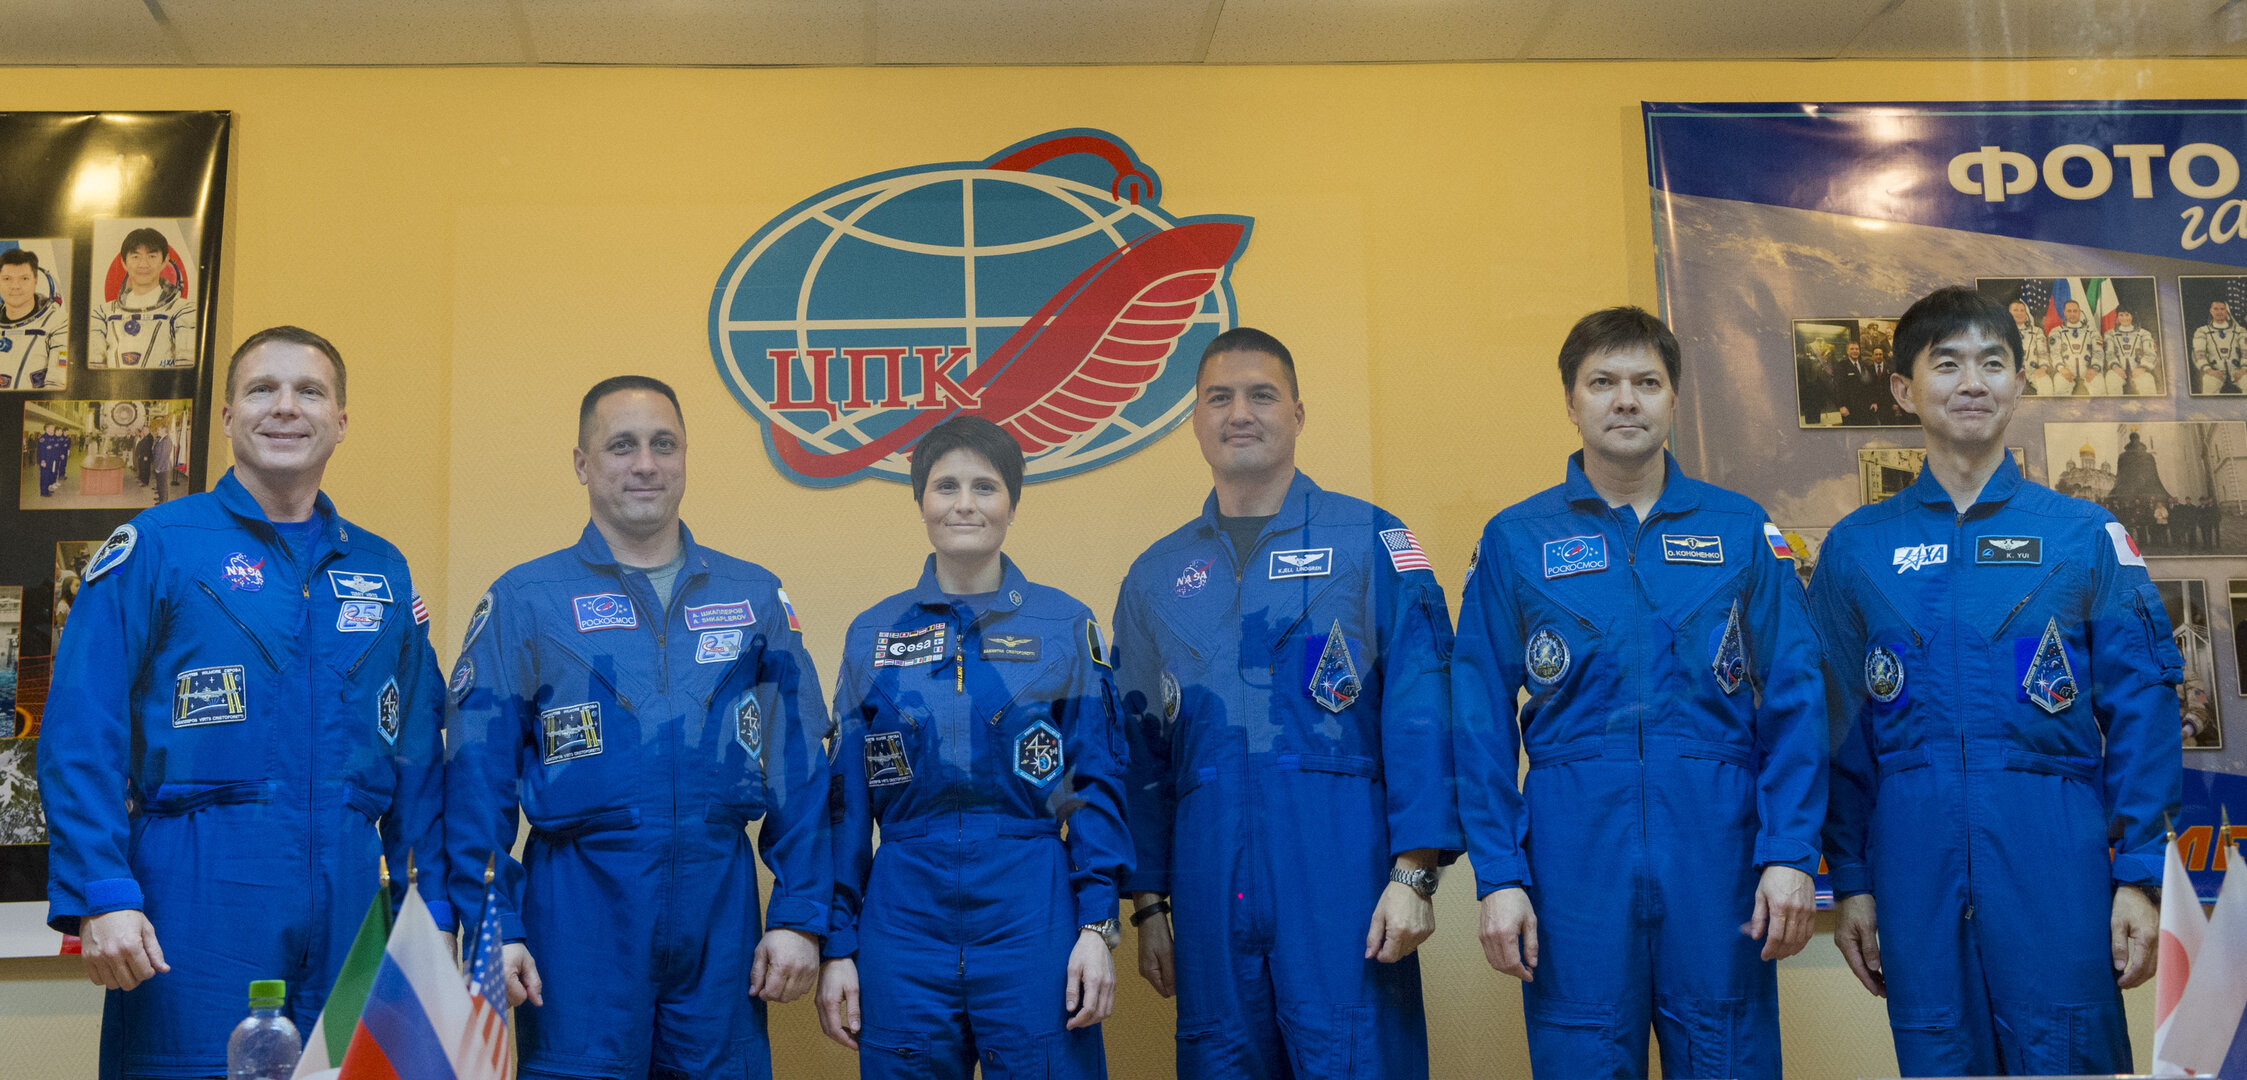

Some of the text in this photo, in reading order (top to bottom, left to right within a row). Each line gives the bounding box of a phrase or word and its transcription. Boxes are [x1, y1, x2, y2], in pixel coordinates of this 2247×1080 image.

[1947, 142, 2240, 202] ФОТО
[767, 346, 981, 422] ЦПК
[1676, 551, 1720, 559] КОНОНЕНКО
[1899, 546, 1944, 567] JAXA
[225, 565, 263, 579] NASA
[1548, 560, 1604, 575] РОСКОСМОС
[1176, 571, 1207, 586] NASA
[581, 616, 635, 628] РОСКОСМОС
[907, 639, 931, 652] esa
